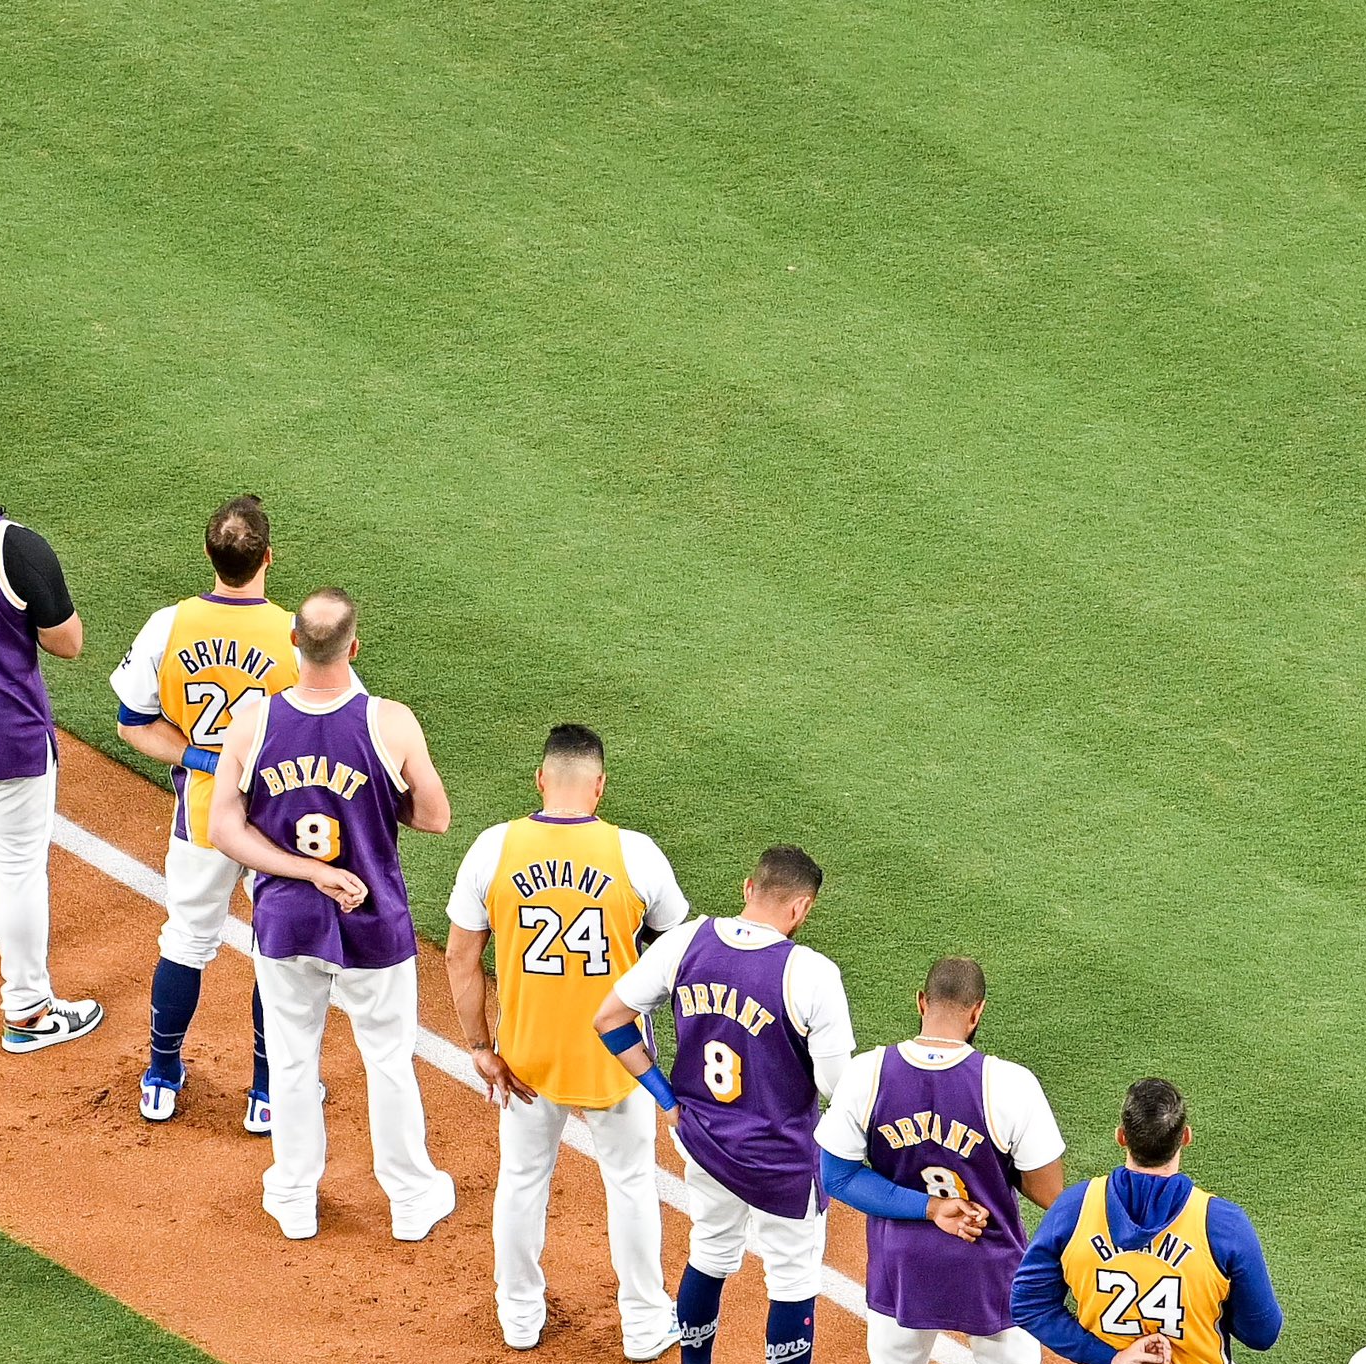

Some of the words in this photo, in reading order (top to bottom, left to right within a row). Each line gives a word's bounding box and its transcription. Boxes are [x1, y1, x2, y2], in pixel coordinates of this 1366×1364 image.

[178, 638, 276, 681] BRYANT
[260, 755, 369, 800] BRYANT
[295, 813, 340, 862] 8
[511, 859, 613, 900] BRYANT
[519, 905, 610, 976] 24
[676, 984, 775, 1036] BRYANT
[703, 1040, 741, 1103] 8
[878, 1110, 985, 1158] BRYANT
[920, 1166, 969, 1200] 8
[1095, 1268, 1185, 1340] 24
